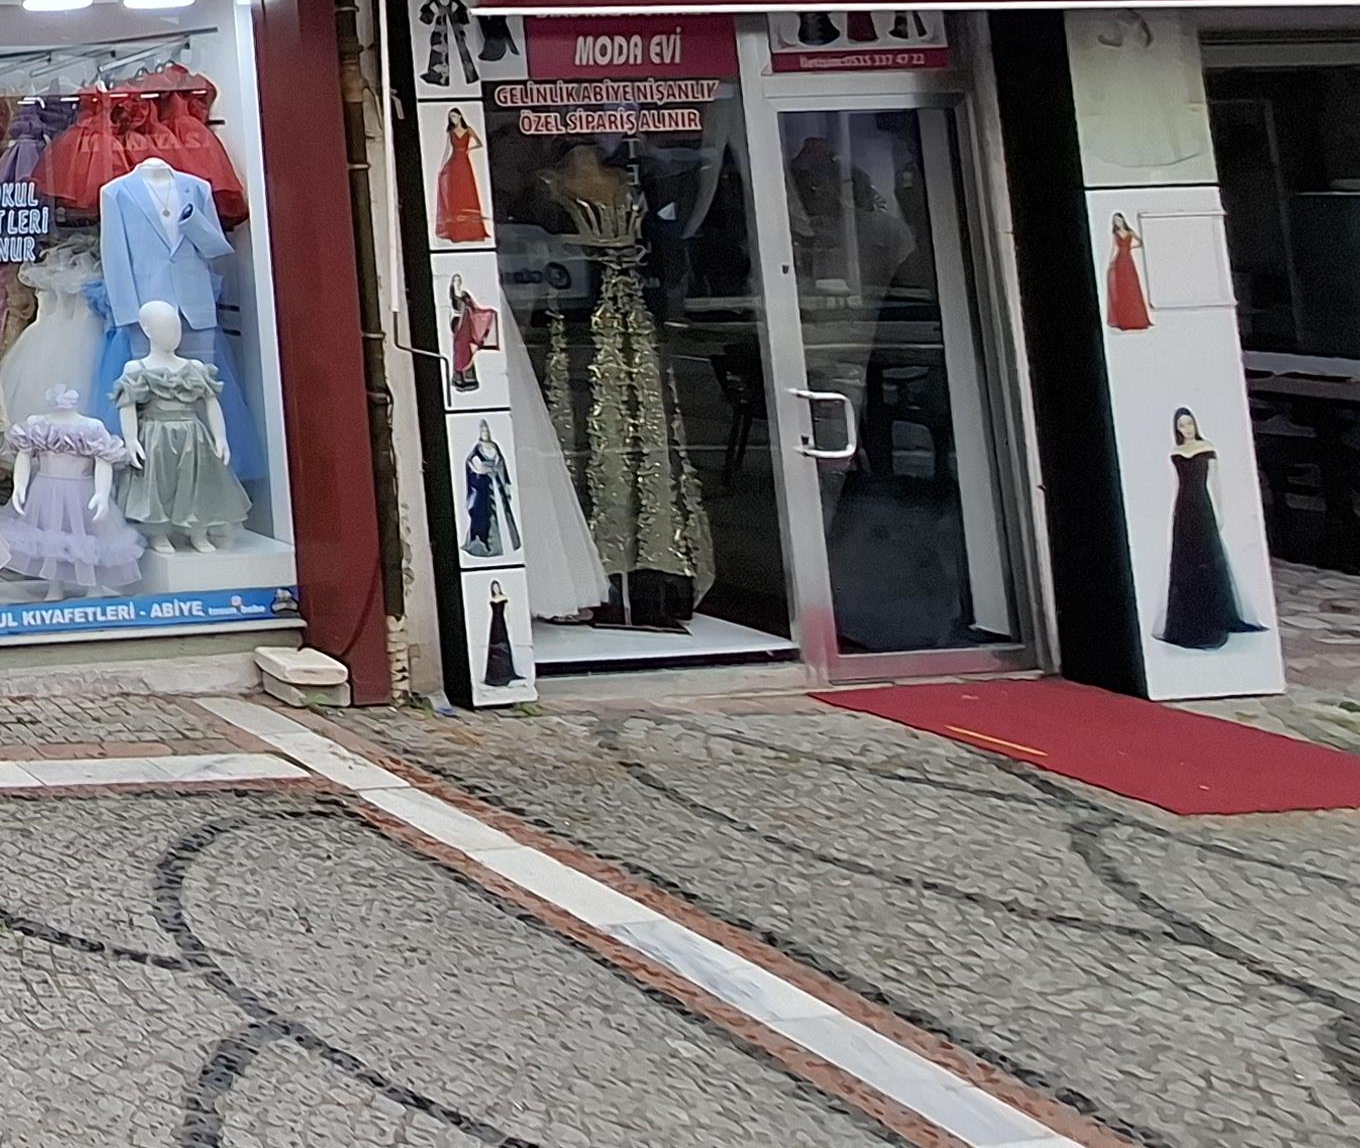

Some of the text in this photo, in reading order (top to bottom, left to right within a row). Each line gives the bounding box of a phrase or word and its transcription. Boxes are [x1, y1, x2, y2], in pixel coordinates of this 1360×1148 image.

[575, 26, 683, 66] MODA EVİ
[495, 79, 578, 107] GELİNLİK
[581, 77, 636, 104] ABİYE
[519, 107, 702, 135] ÖZEL SİPARİŞ ALINIR
[22, 601, 136, 627] KIYAFETLERİ
[149, 598, 205, 620] ABİYE
